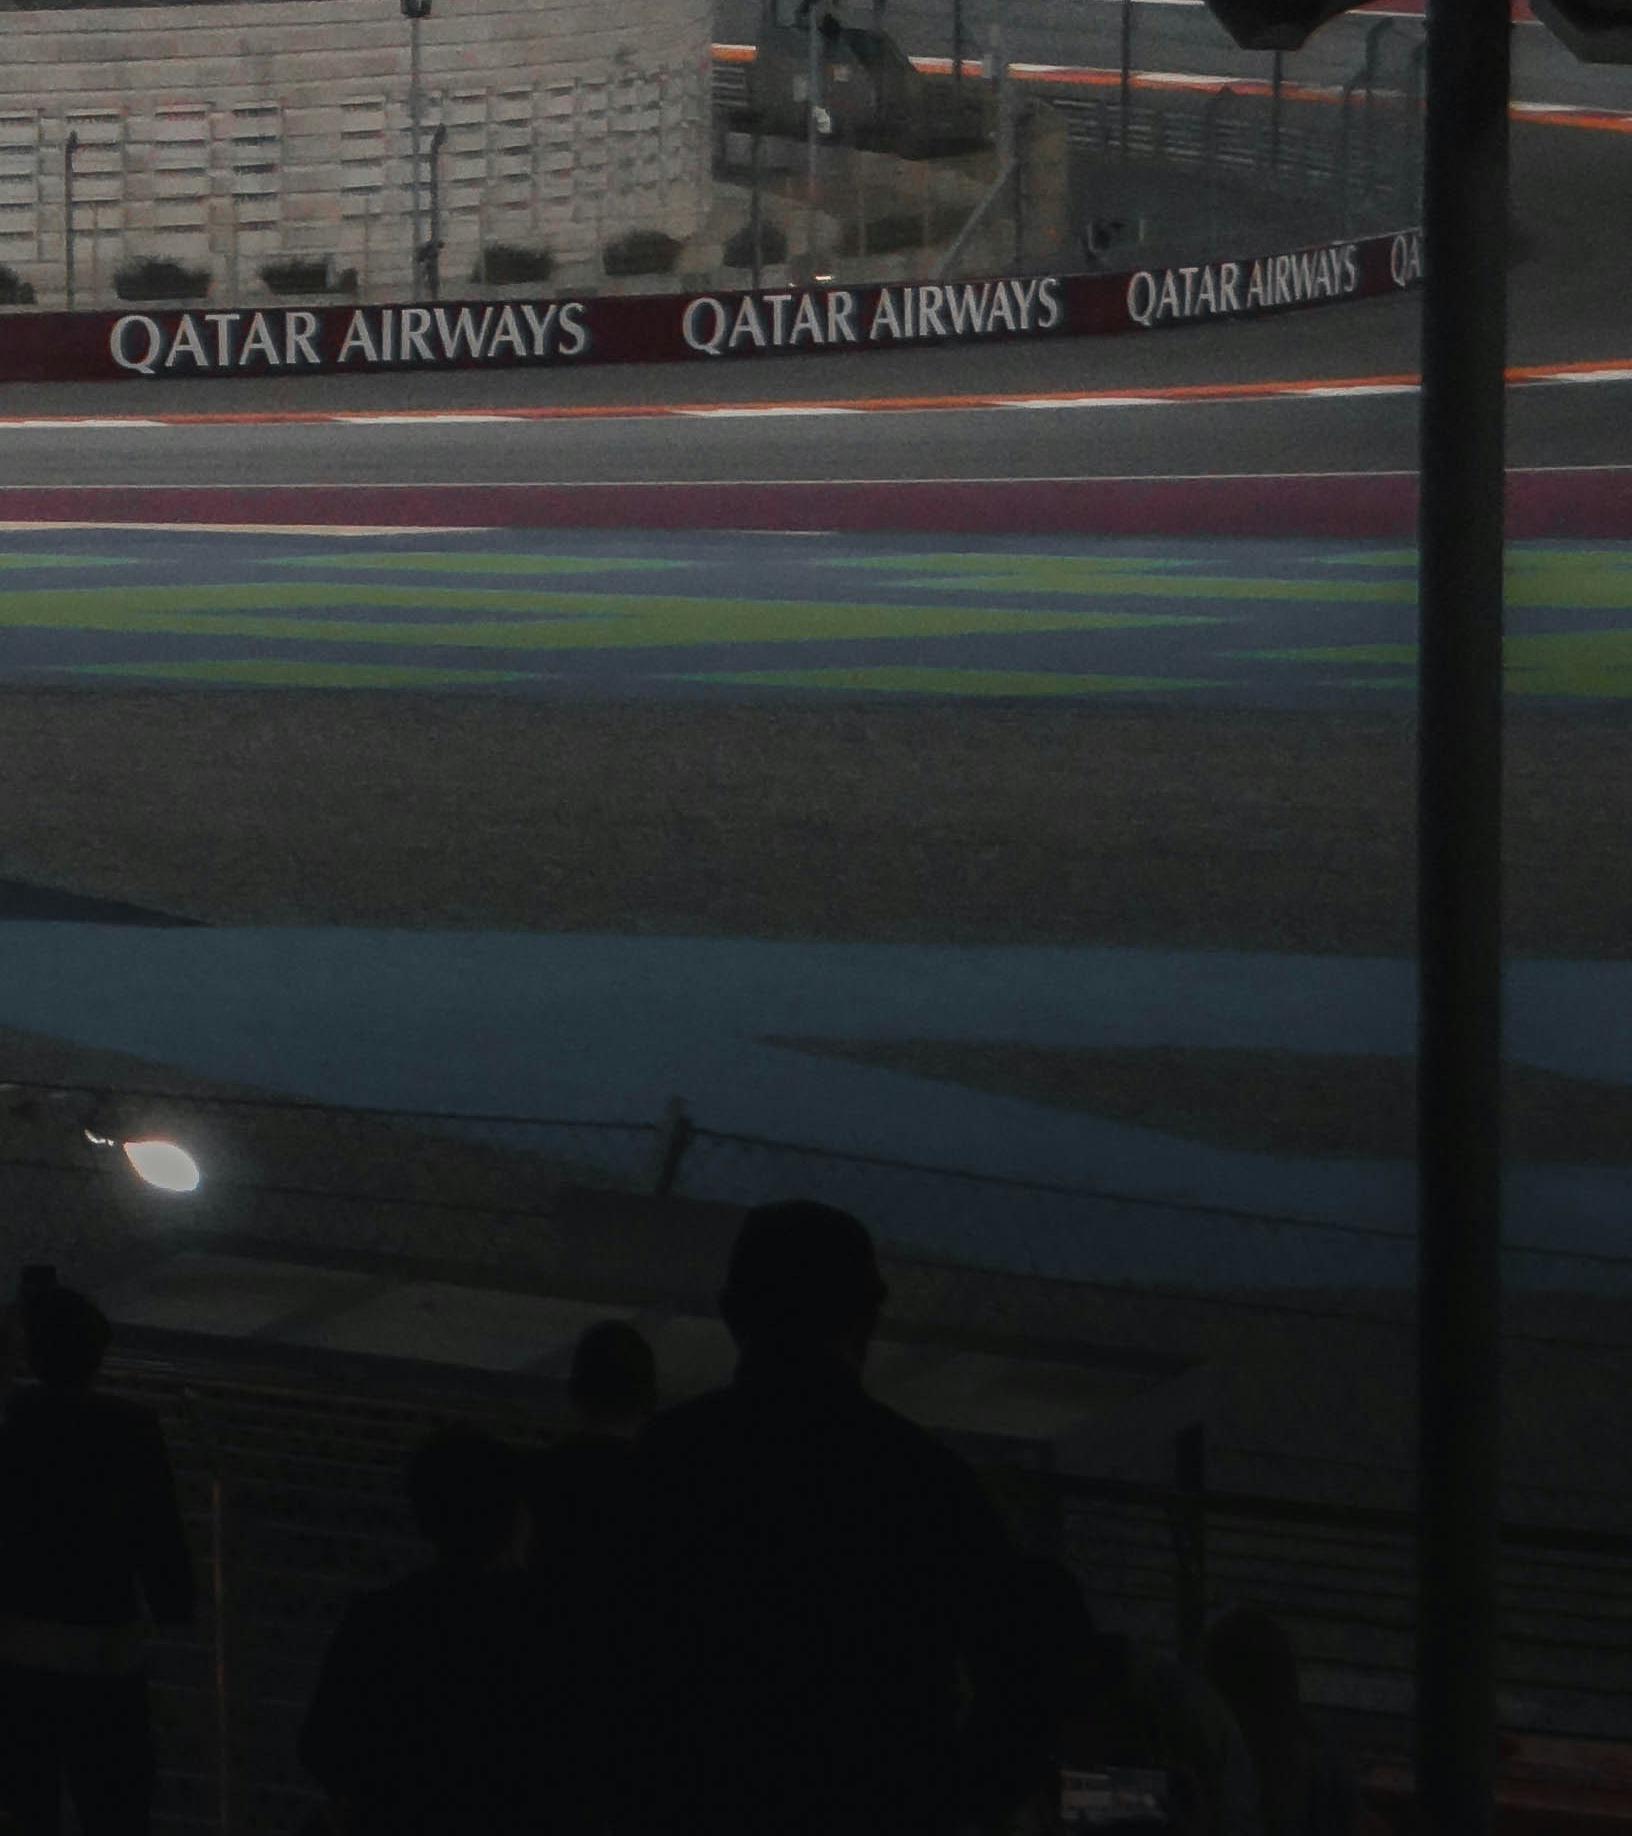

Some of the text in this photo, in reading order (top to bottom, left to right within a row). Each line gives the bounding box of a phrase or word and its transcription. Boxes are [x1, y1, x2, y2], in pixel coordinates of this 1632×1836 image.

[682, 278, 1059, 354] QATAR AIRWAYS
[1127, 263, 1239, 327] QATAR
[1247, 245, 1357, 309] AIRWAYS
[109, 304, 585, 373] QATAR AIRWAYS
